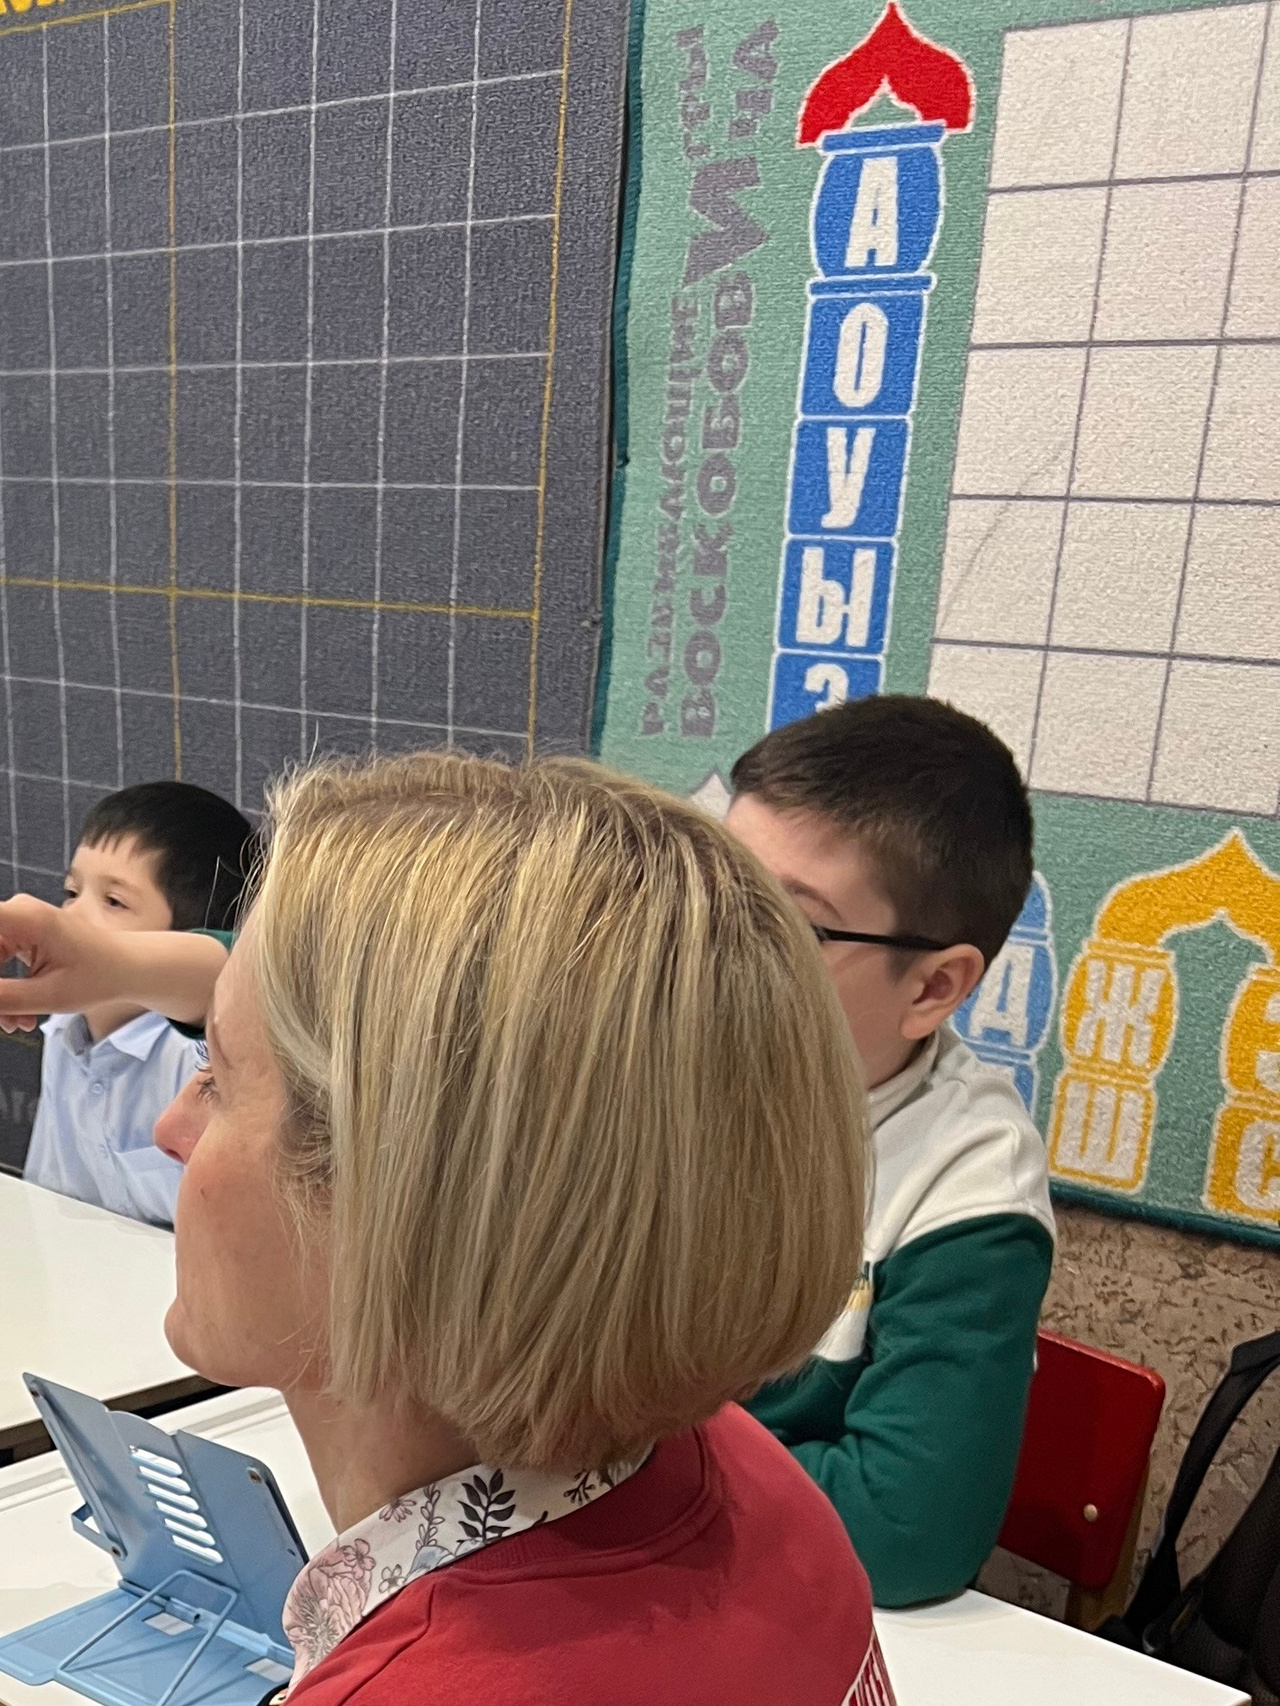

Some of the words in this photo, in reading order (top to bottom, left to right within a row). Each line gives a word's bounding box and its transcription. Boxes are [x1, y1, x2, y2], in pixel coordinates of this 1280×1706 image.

[639, 294, 705, 738] РАЗВИВАЮЩИЕ
[680, 19, 780, 739] ВОСКОБОВИЧА
[1055, 1080, 1147, 1181] Ш
[1074, 957, 1166, 1068] Ж
